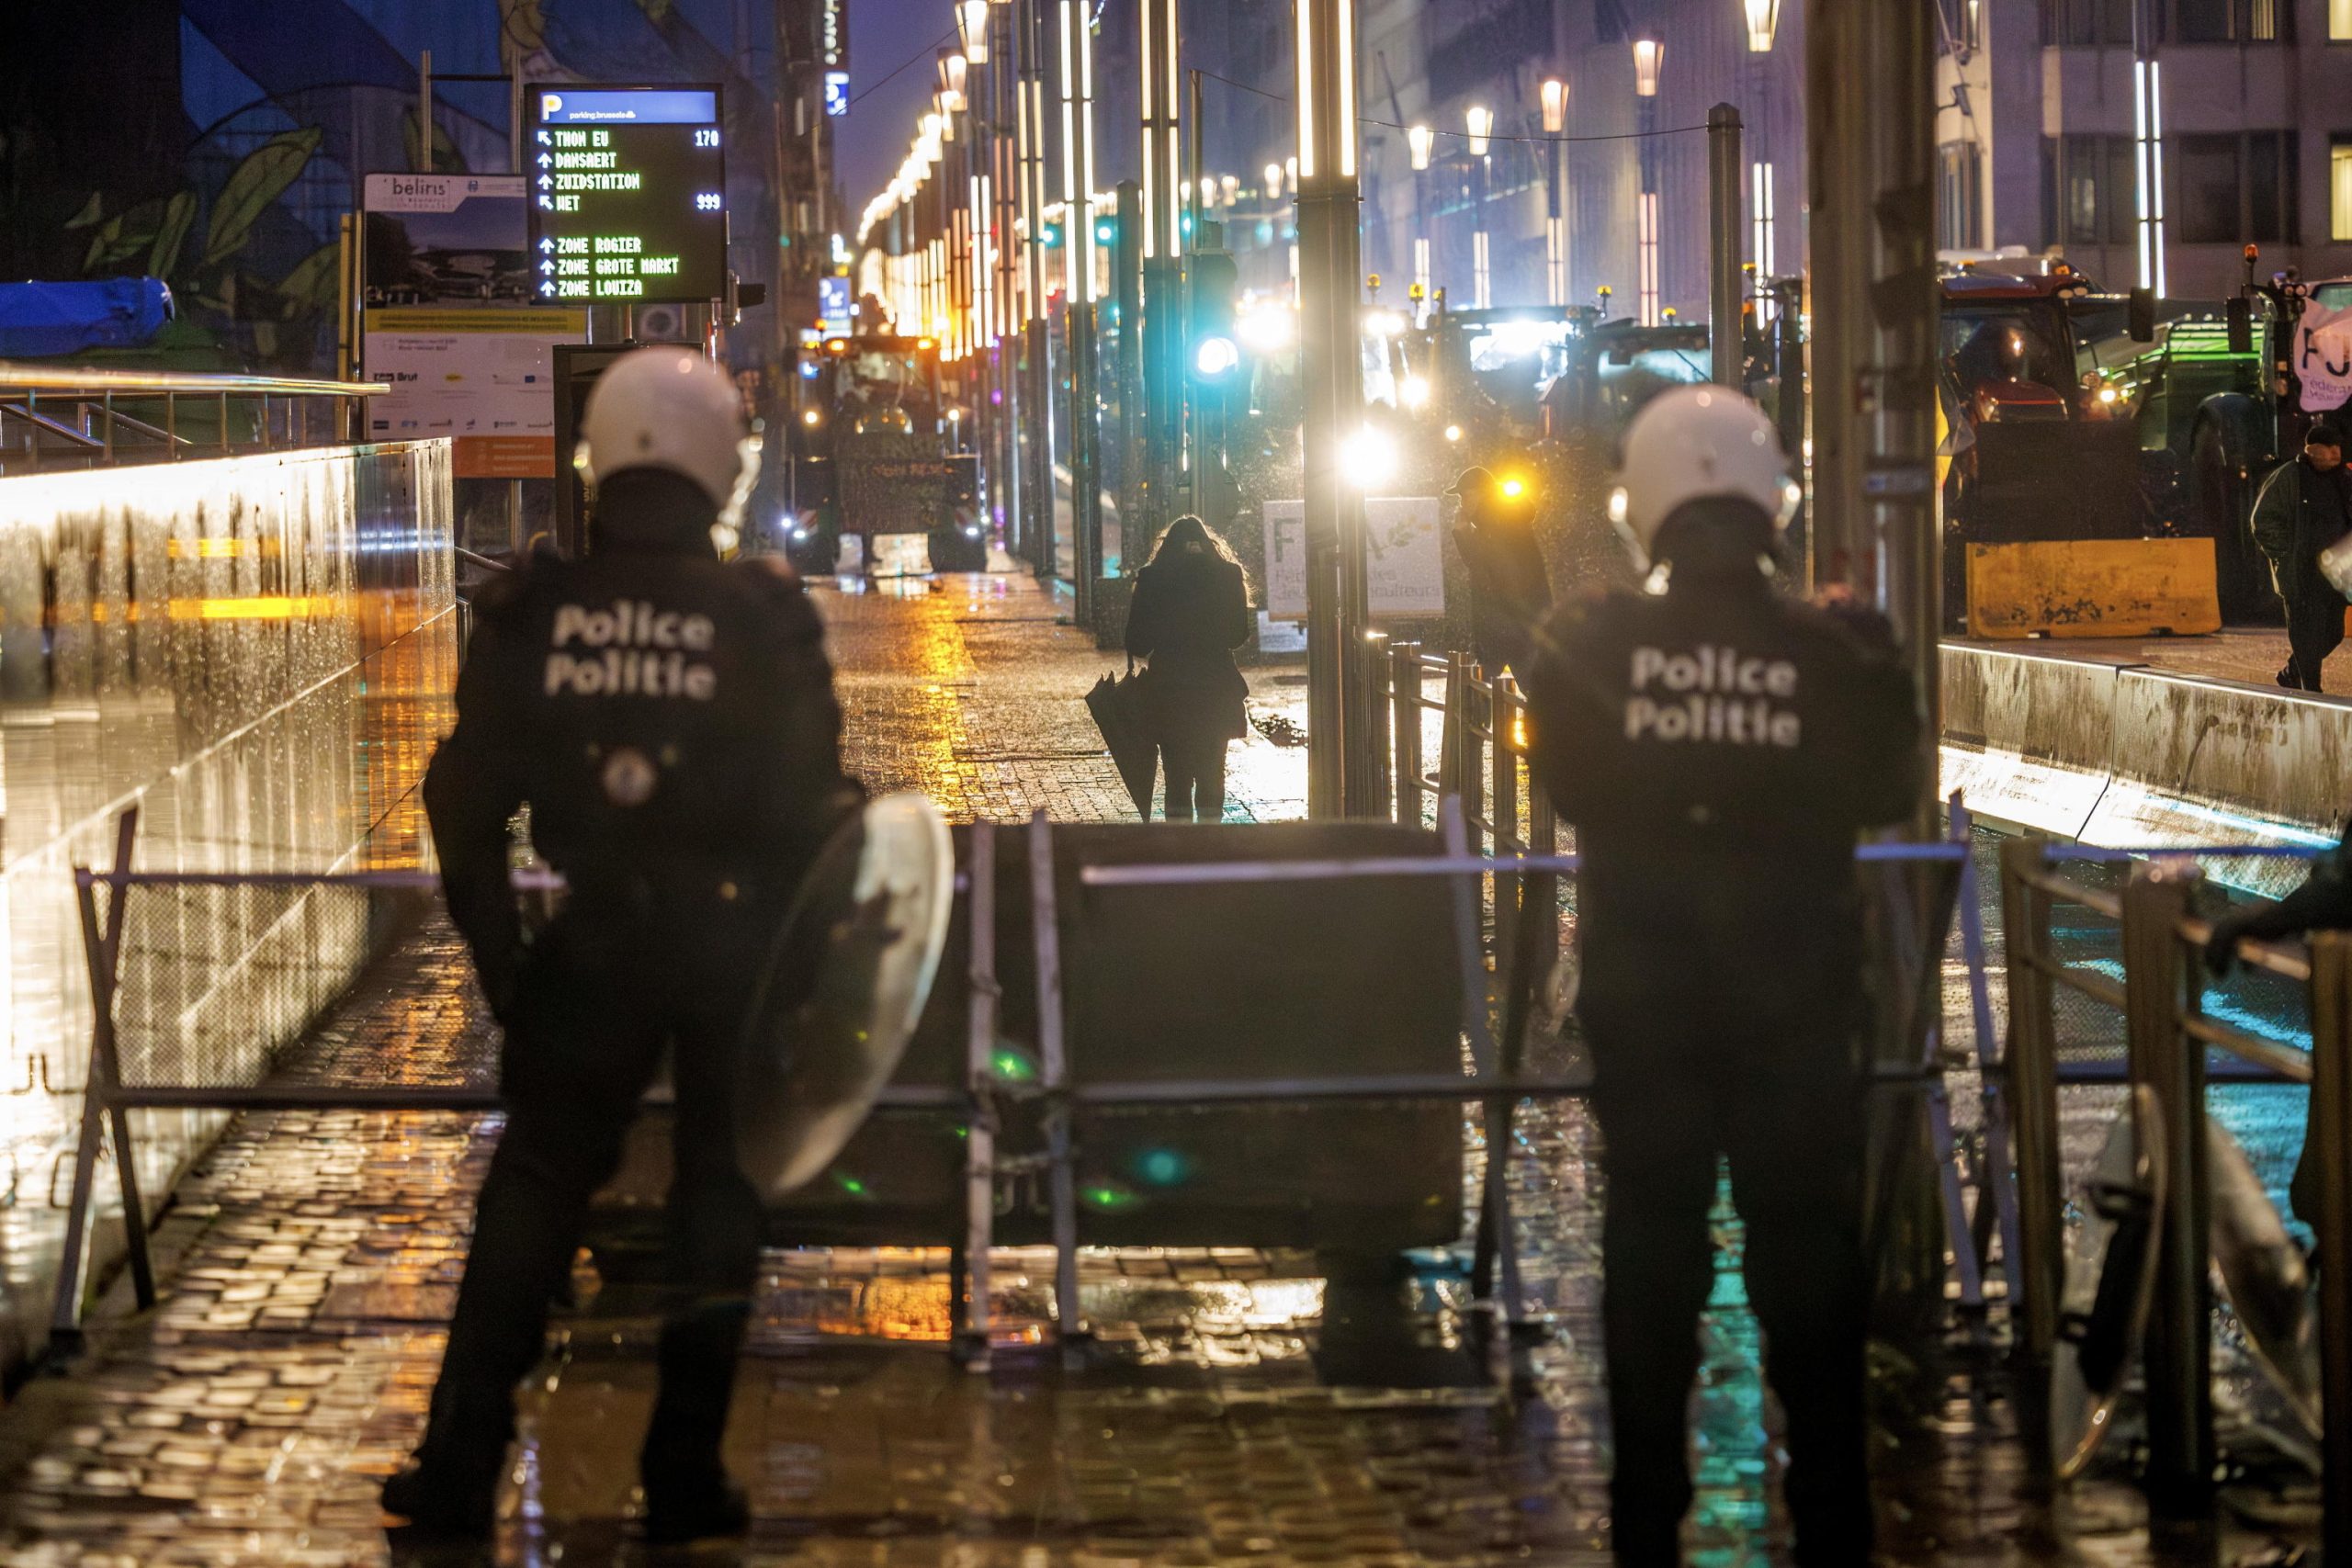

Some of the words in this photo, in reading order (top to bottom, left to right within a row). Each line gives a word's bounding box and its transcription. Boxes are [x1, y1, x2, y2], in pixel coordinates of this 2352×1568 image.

[593, 131, 608, 146] EU
[556, 152, 616, 168] DANSAERT
[392, 177, 446, 196] beliris
[556, 174, 639, 189] ZUIDSTATION
[557, 196, 580, 210] WET
[696, 195, 720, 209] 999
[558, 238, 588, 254] ZONE
[595, 238, 641, 253] ROGIER
[558, 259, 589, 275] ZONE
[596, 259, 633, 274] GROTE
[641, 258, 679, 274] MARKT
[559, 280, 590, 296] ZONE
[596, 280, 642, 296] LOUIZA
[552, 599, 715, 651] Police
[545, 650, 717, 702] Politie
[1630, 645, 1798, 698] Police
[1624, 694, 1801, 748] Politie
